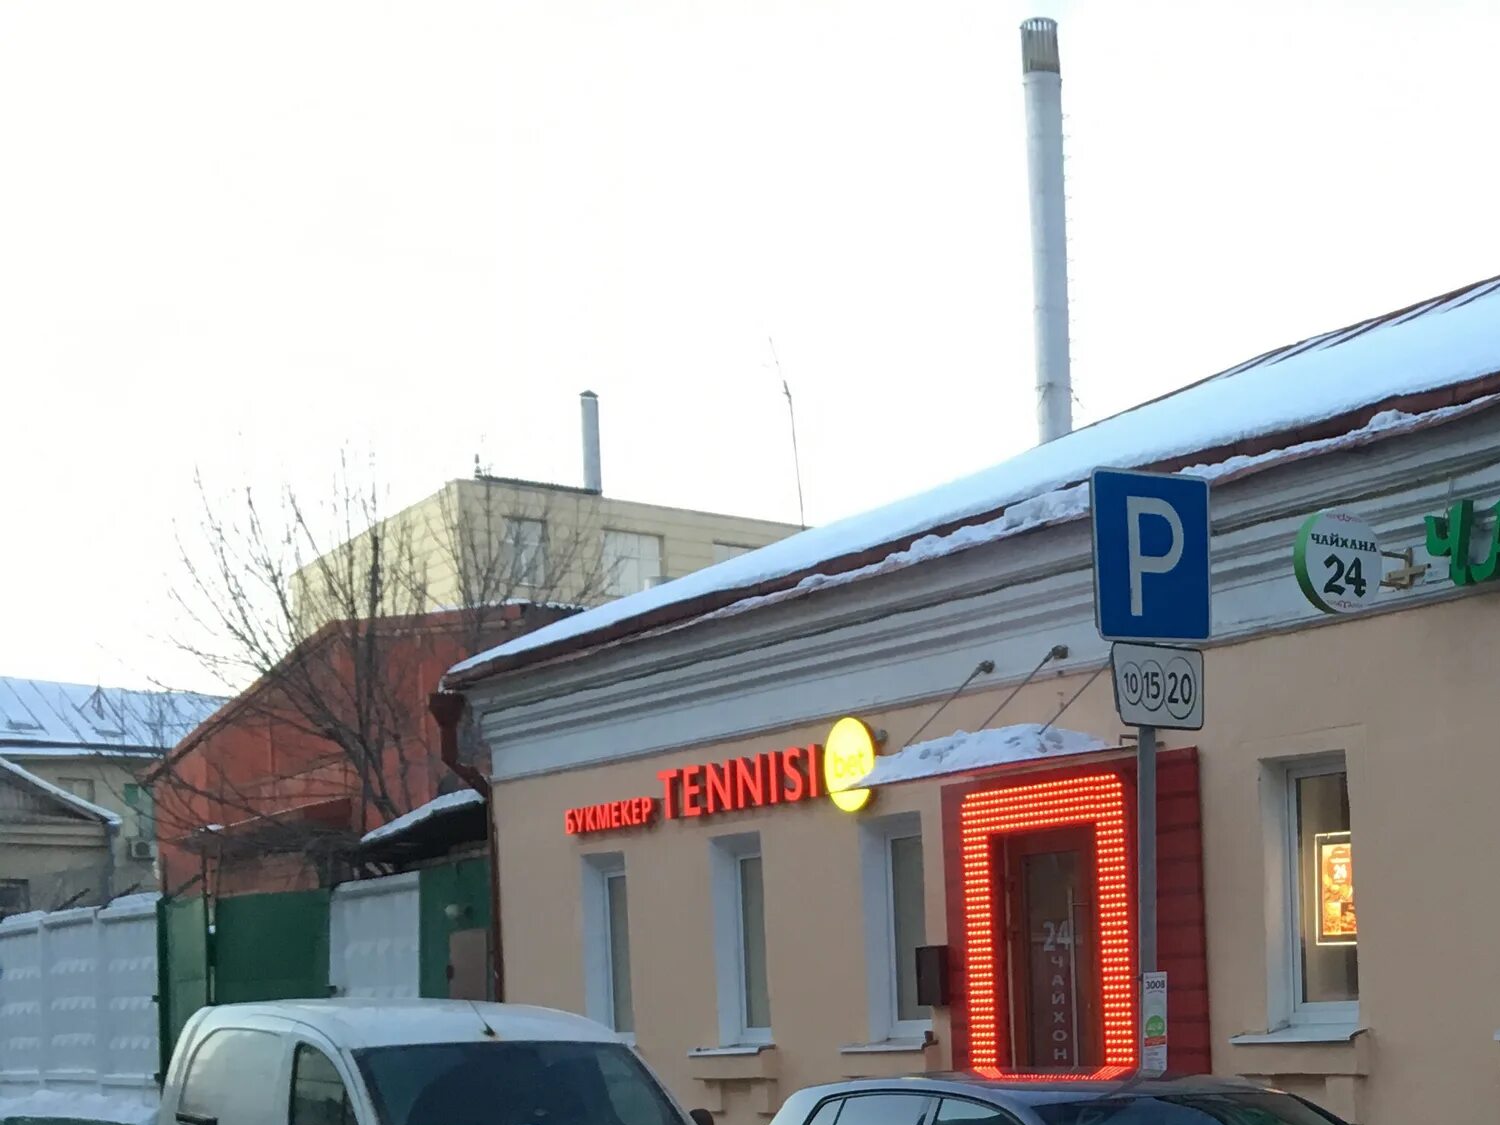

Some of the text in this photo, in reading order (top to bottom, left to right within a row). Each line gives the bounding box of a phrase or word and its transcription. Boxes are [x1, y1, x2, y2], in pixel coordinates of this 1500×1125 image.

[1126, 495, 1185, 617] P
[1310, 532, 1378, 553] ЧАЙХАНА
[1323, 553, 1367, 599] 24
[1123, 671, 1193, 705] 10 15 20
[564, 743, 867, 836] БУКМЕКЕР TENNISI bet
